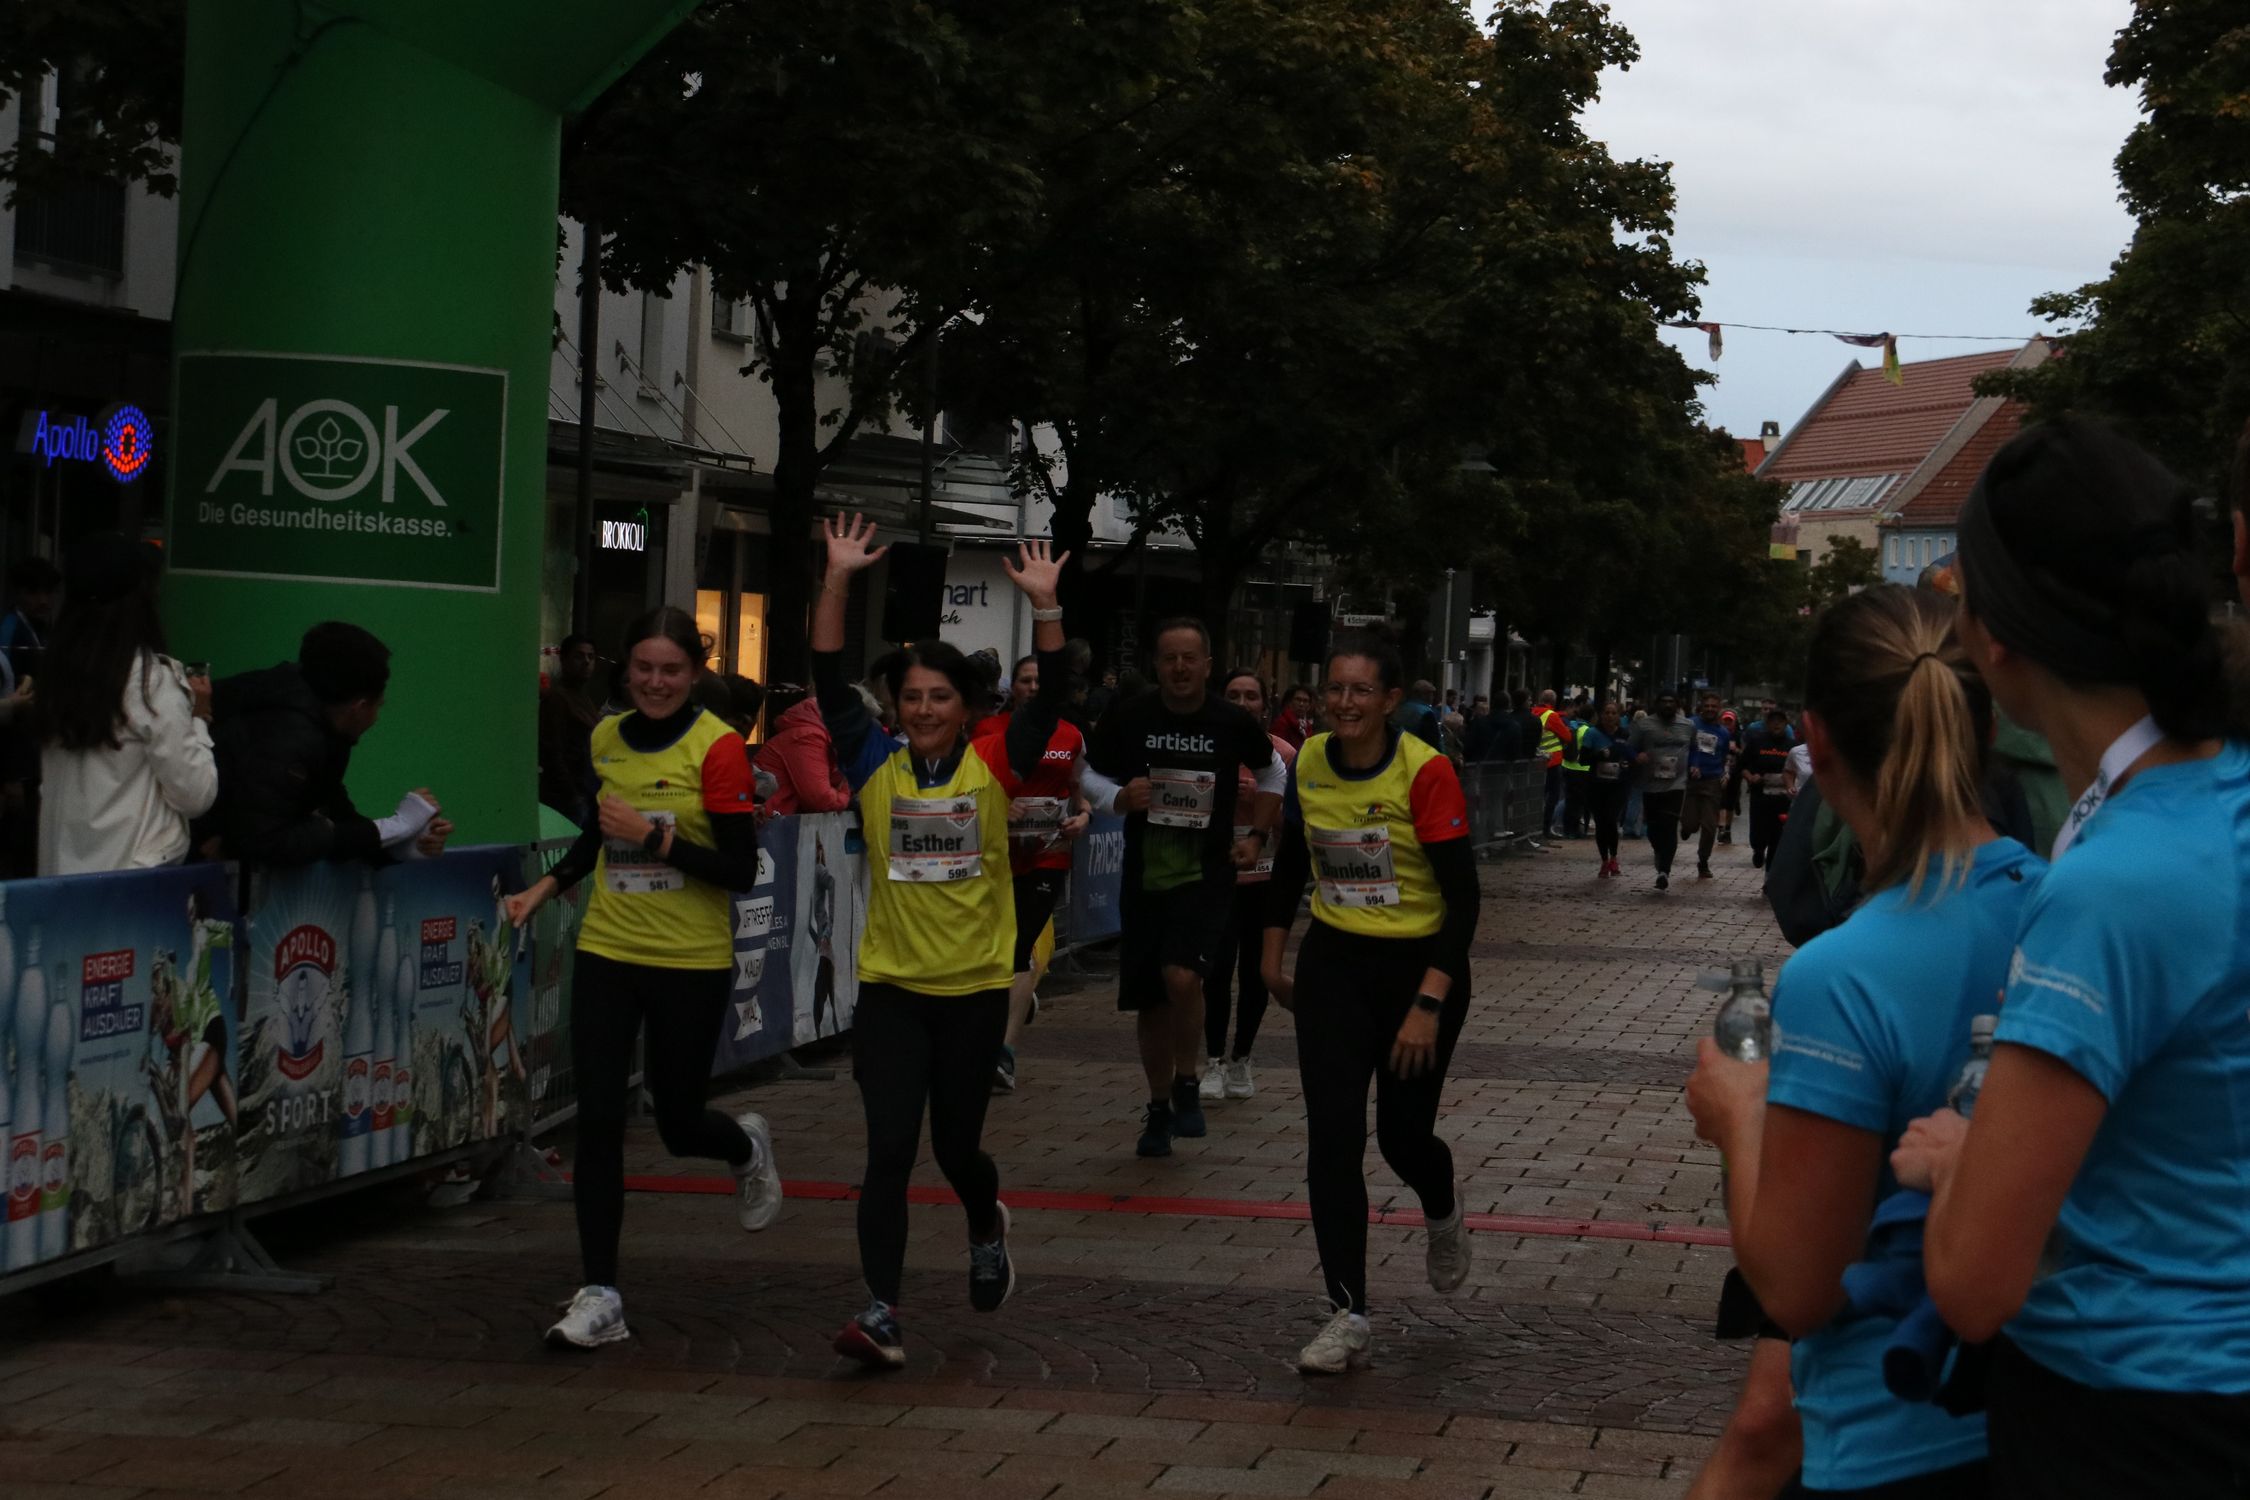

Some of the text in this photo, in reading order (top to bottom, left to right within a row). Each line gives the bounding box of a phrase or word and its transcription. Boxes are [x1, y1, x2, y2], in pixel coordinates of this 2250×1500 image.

[32, 409, 99, 468] Apollo
[205, 397, 451, 506] AOK
[198, 502, 453, 537] Die Gesundheitskasse.
[602, 520, 645, 552] BROKKOLI
[1145, 732, 1215, 753] artistic
[1163, 792, 1198, 809] Carlo
[2072, 788, 2101, 830] AOK
[1188, 820, 1203, 828] 294
[605, 846, 661, 864] Vaness
[902, 834, 964, 852] Esther
[948, 868, 968, 879] 595
[1321, 862, 1382, 879] Daniela
[650, 880, 669, 891] 581
[1365, 894, 1385, 905] 594
[279, 931, 330, 973] APOLLO
[86, 952, 132, 981] ENERGIE
[82, 1006, 142, 1038] AUSDAUER
[265, 1090, 332, 1136] SPORT
